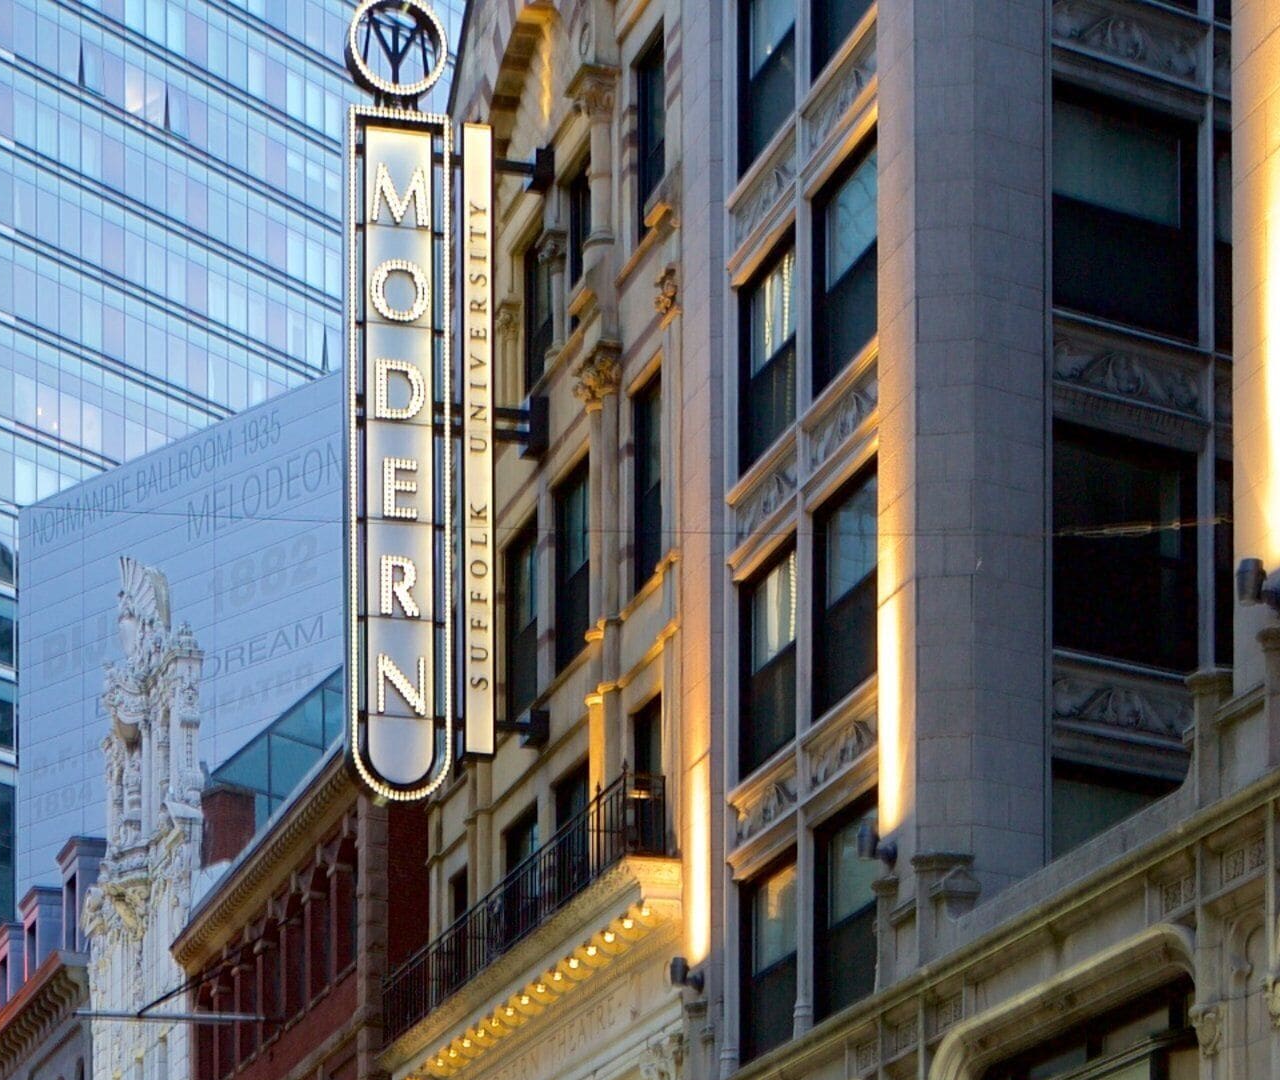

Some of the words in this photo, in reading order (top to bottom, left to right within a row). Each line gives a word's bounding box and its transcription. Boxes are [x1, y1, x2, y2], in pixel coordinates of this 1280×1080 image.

[470, 200, 487, 453] UNIVERSITY
[32, 477, 130, 547] NORMANDIE
[136, 436, 234, 501] BALLROOM
[241, 409, 281, 457] 1935
[370, 160, 430, 717] MODERN
[202, 615, 323, 678] DREAM
[207, 535, 317, 614] 1882
[470, 503, 489, 691] SUFFOLK
